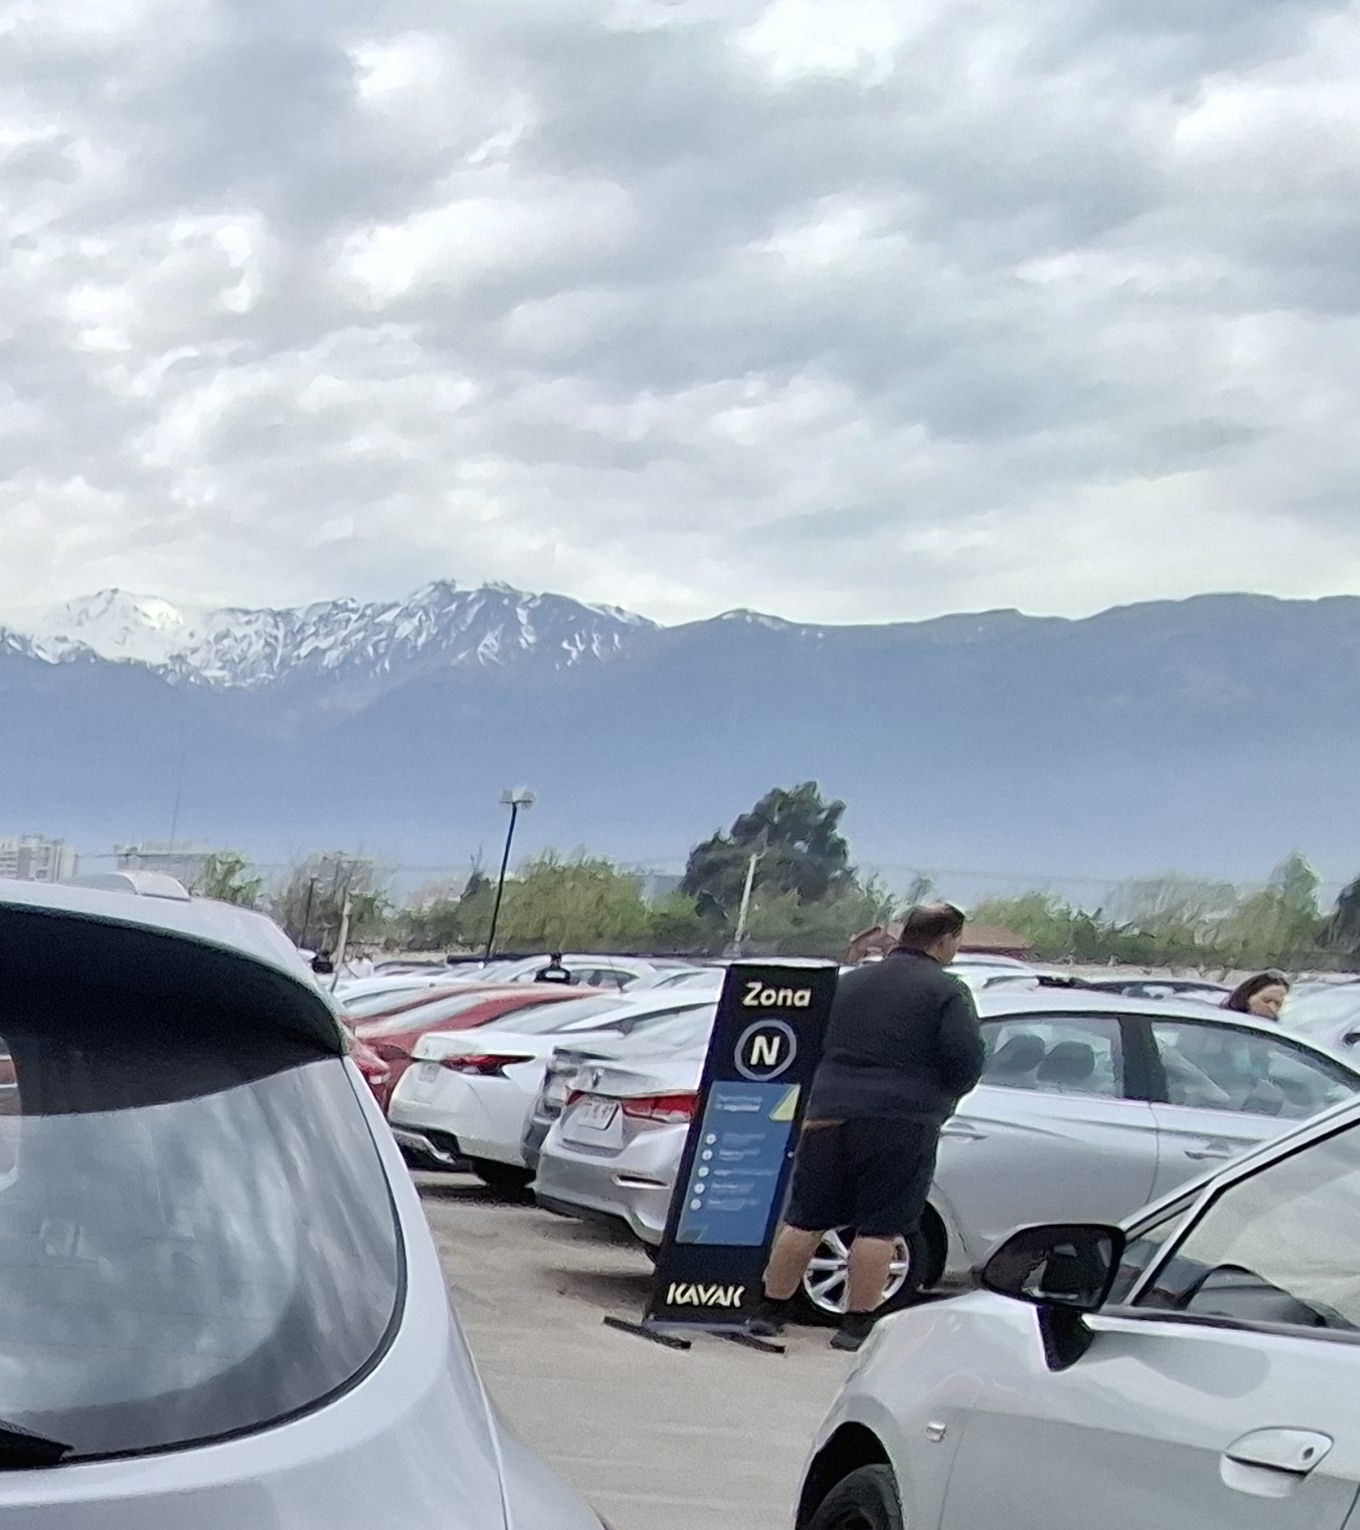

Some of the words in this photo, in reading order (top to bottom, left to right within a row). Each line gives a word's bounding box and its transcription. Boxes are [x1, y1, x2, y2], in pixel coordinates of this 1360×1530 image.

[742, 981, 812, 1007] Zona
[749, 1035, 781, 1066] N
[666, 1282, 746, 1308] KAVAK
